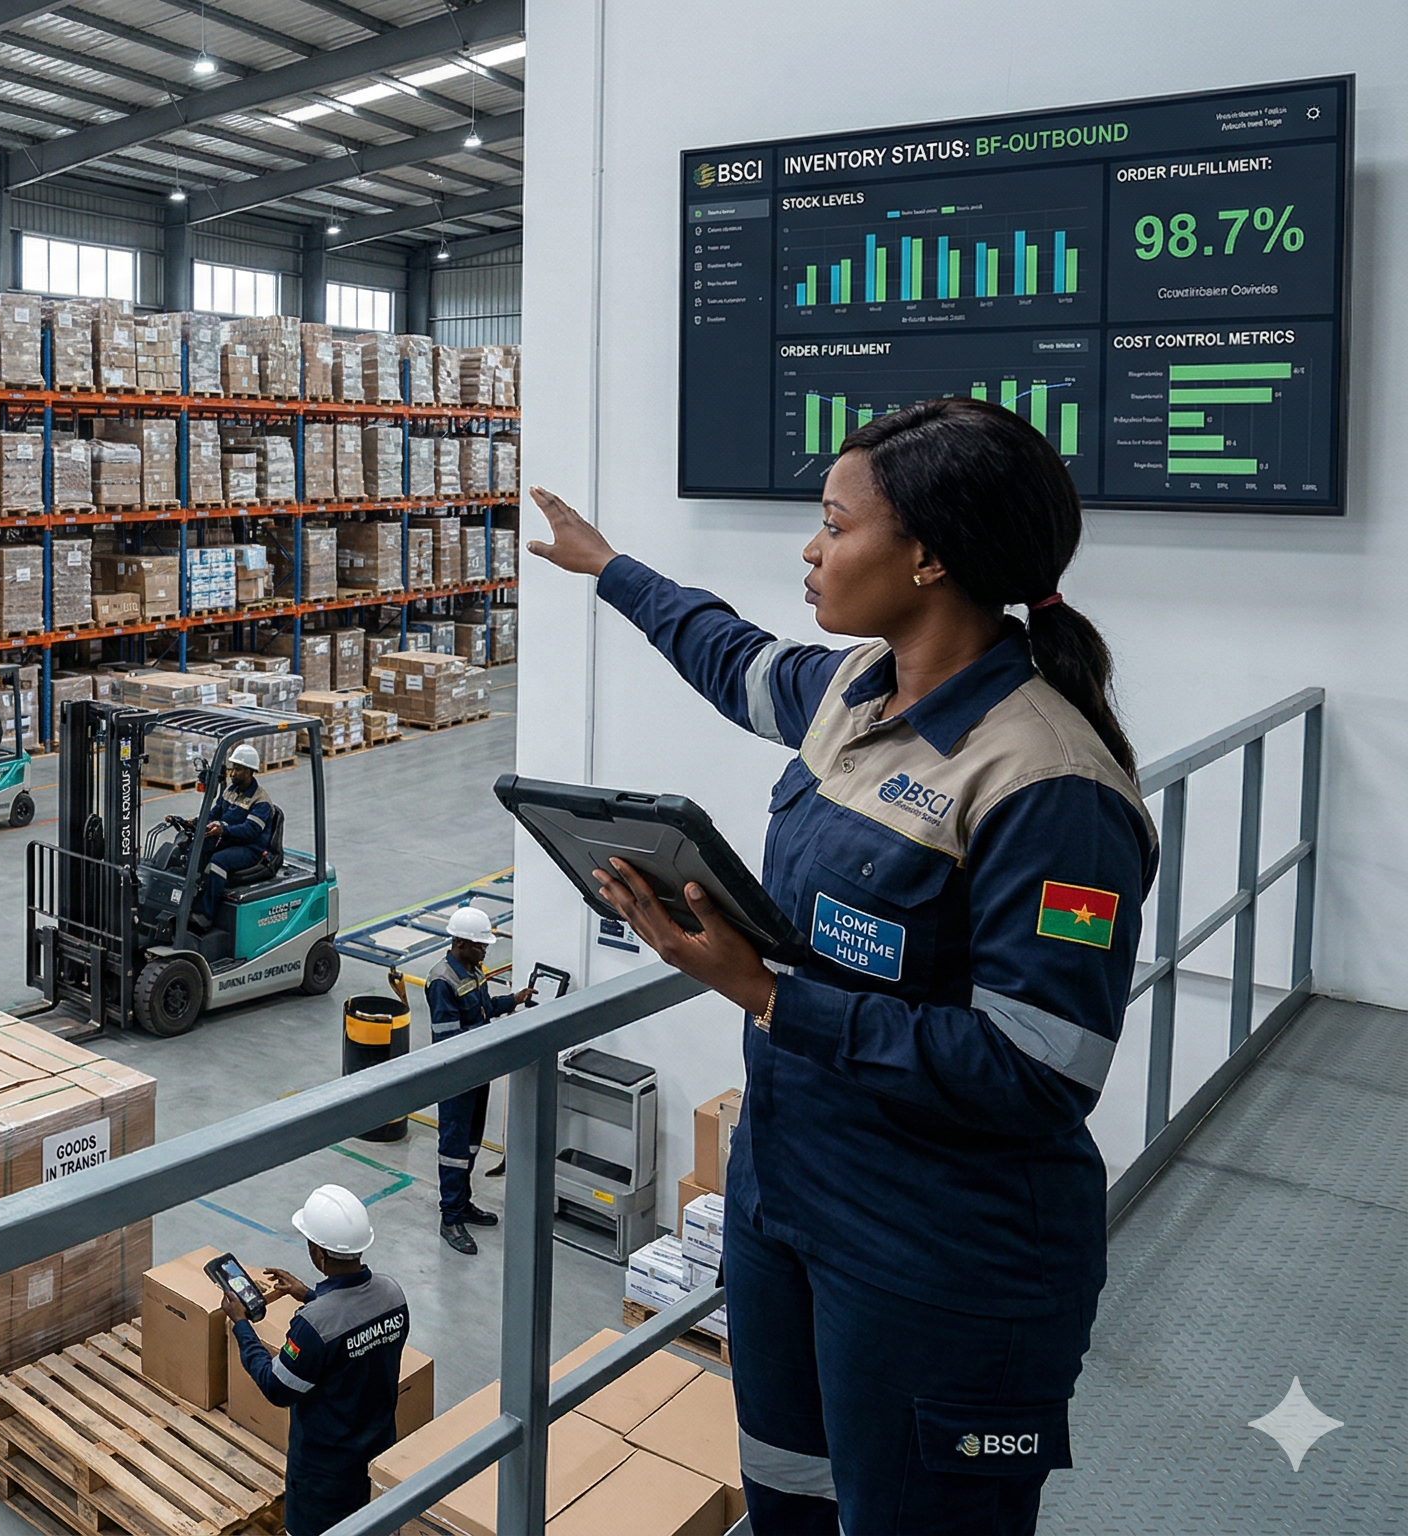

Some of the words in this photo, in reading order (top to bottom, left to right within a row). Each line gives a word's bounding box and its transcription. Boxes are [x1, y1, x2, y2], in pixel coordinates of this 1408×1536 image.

[785, 148, 887, 174] INVENTORY
[892, 140, 969, 166] STATUS:
[976, 123, 1129, 156] BF-OUTBOUND
[718, 160, 762, 183] BSCI
[1116, 165, 1166, 182] ORDER
[1170, 157, 1273, 178] FULFILLMENT:
[782, 195, 820, 210] STOCK
[822, 192, 865, 207] LEVELS
[1134, 205, 1305, 261] 98.7%
[780, 345, 819, 357] ORDER
[821, 343, 891, 356] FUFILLMENT
[1113, 335, 1152, 349] COST
[1155, 332, 1225, 348] CONTROL
[1229, 329, 1296, 346] METRICS
[902, 781, 955, 819] BSCI
[817, 920, 895, 960] MARITIME
[836, 944, 869, 967] HUB
[56, 1135, 97, 1160] GOODS
[45, 1165, 57, 1182] IN
[60, 1149, 107, 1177] TRANSIT
[983, 1433, 1039, 1455] BSCI
